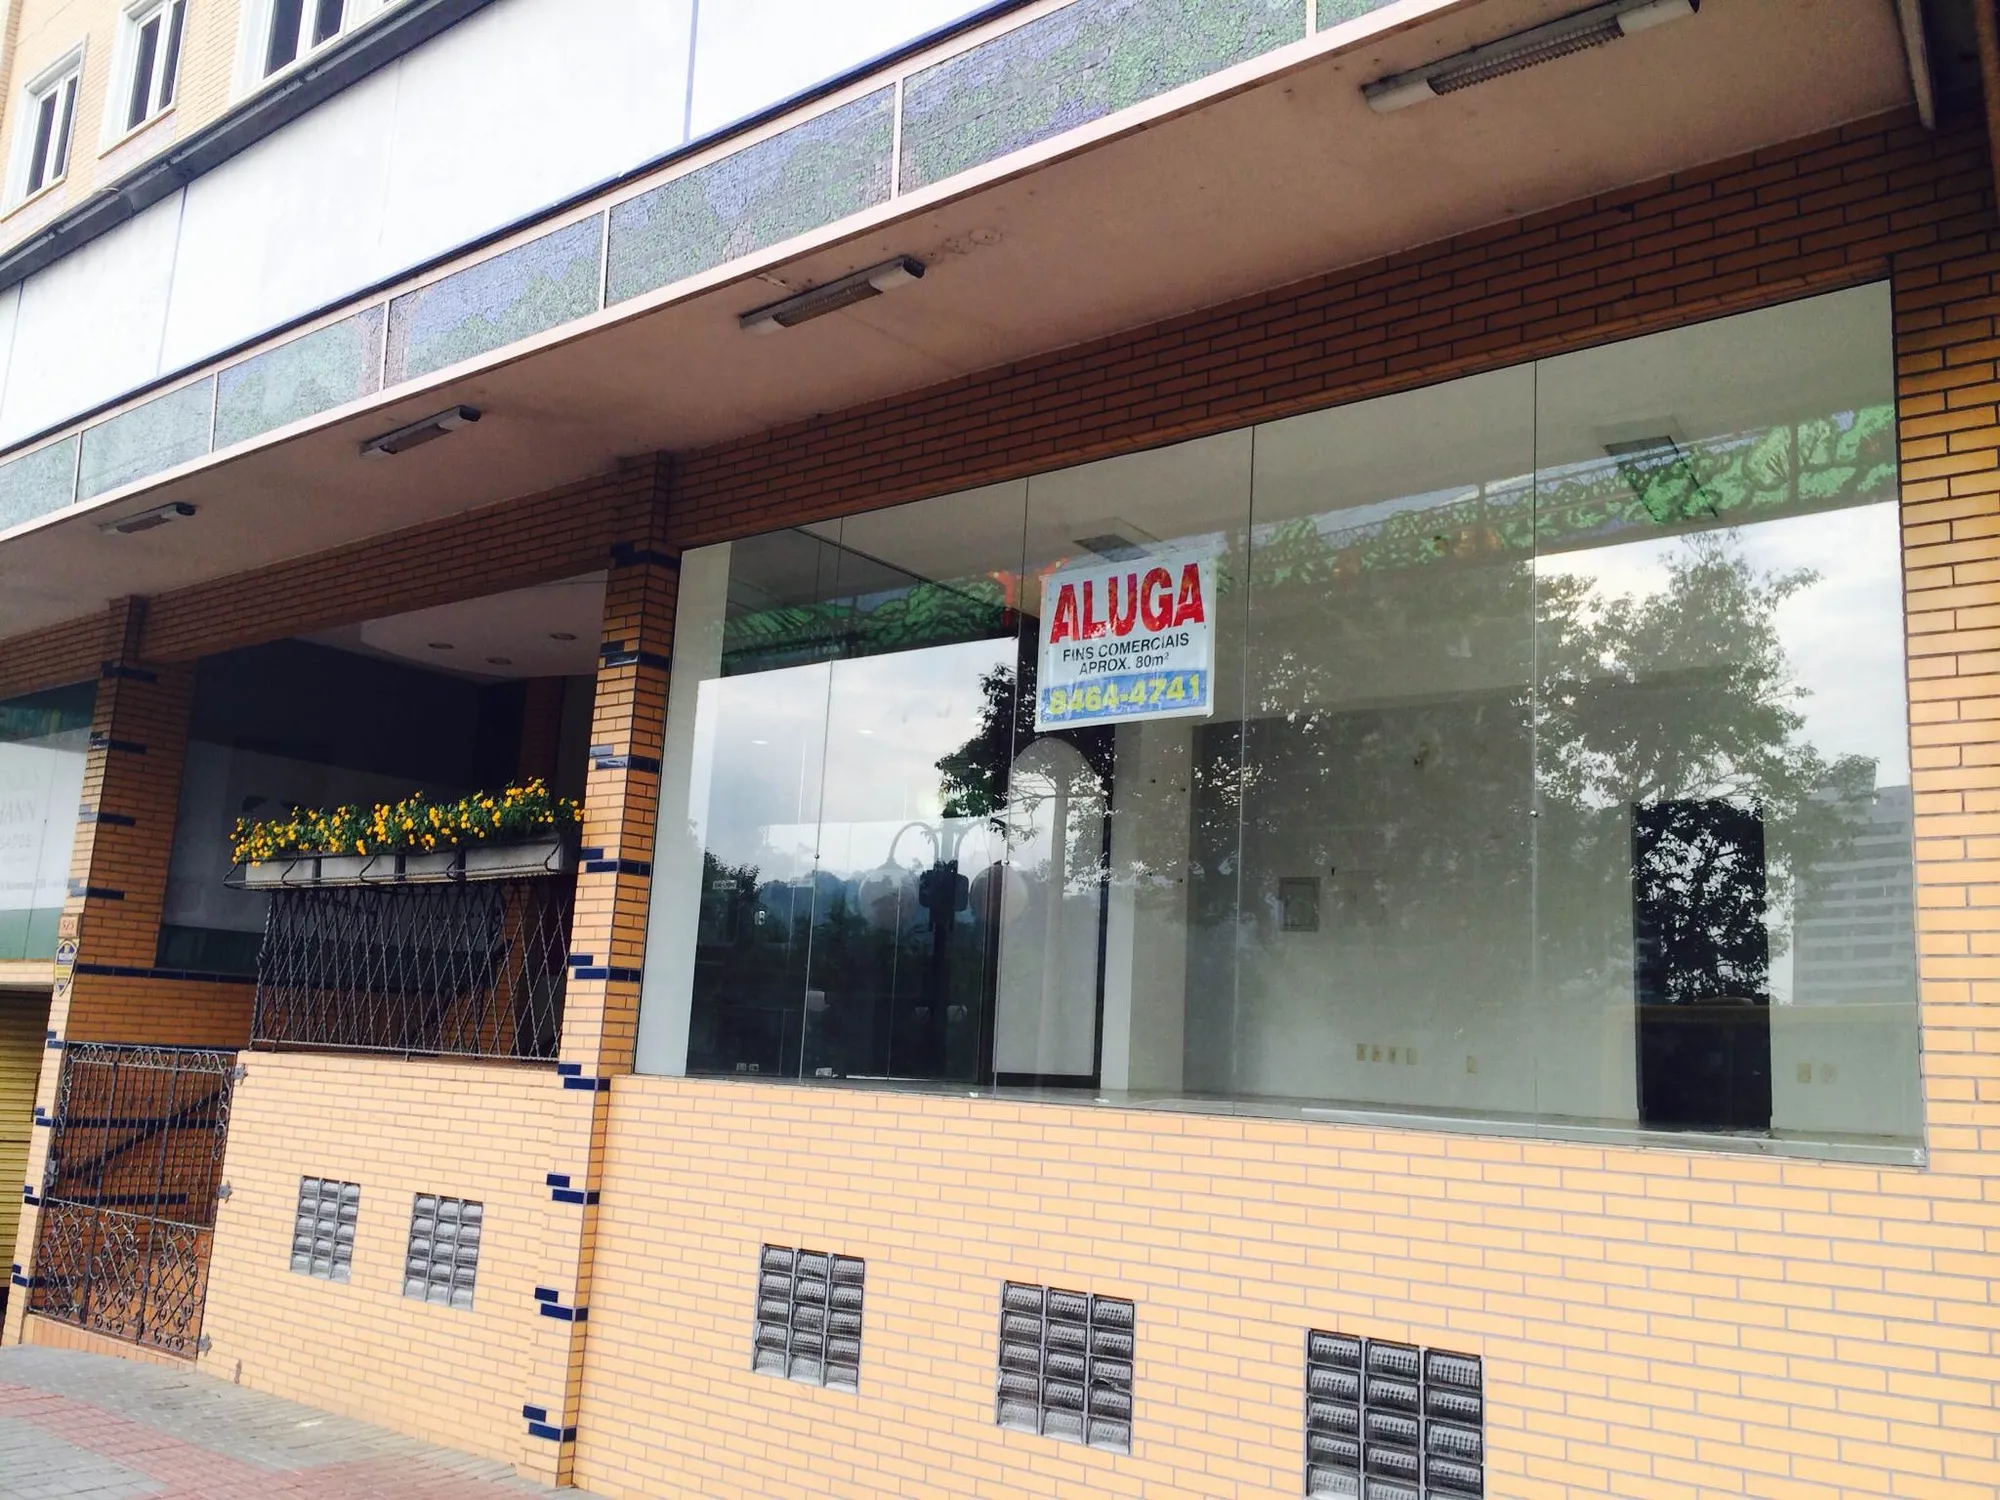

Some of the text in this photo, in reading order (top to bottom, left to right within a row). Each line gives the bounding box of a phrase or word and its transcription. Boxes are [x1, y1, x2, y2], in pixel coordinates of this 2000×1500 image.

[1050, 563, 1204, 644] ALUGA
[1063, 632, 1190, 662] FINS COMERCIAIS
[1079, 657, 1131, 676] APROX.
[1049, 674, 1199, 714] 8464-4741
